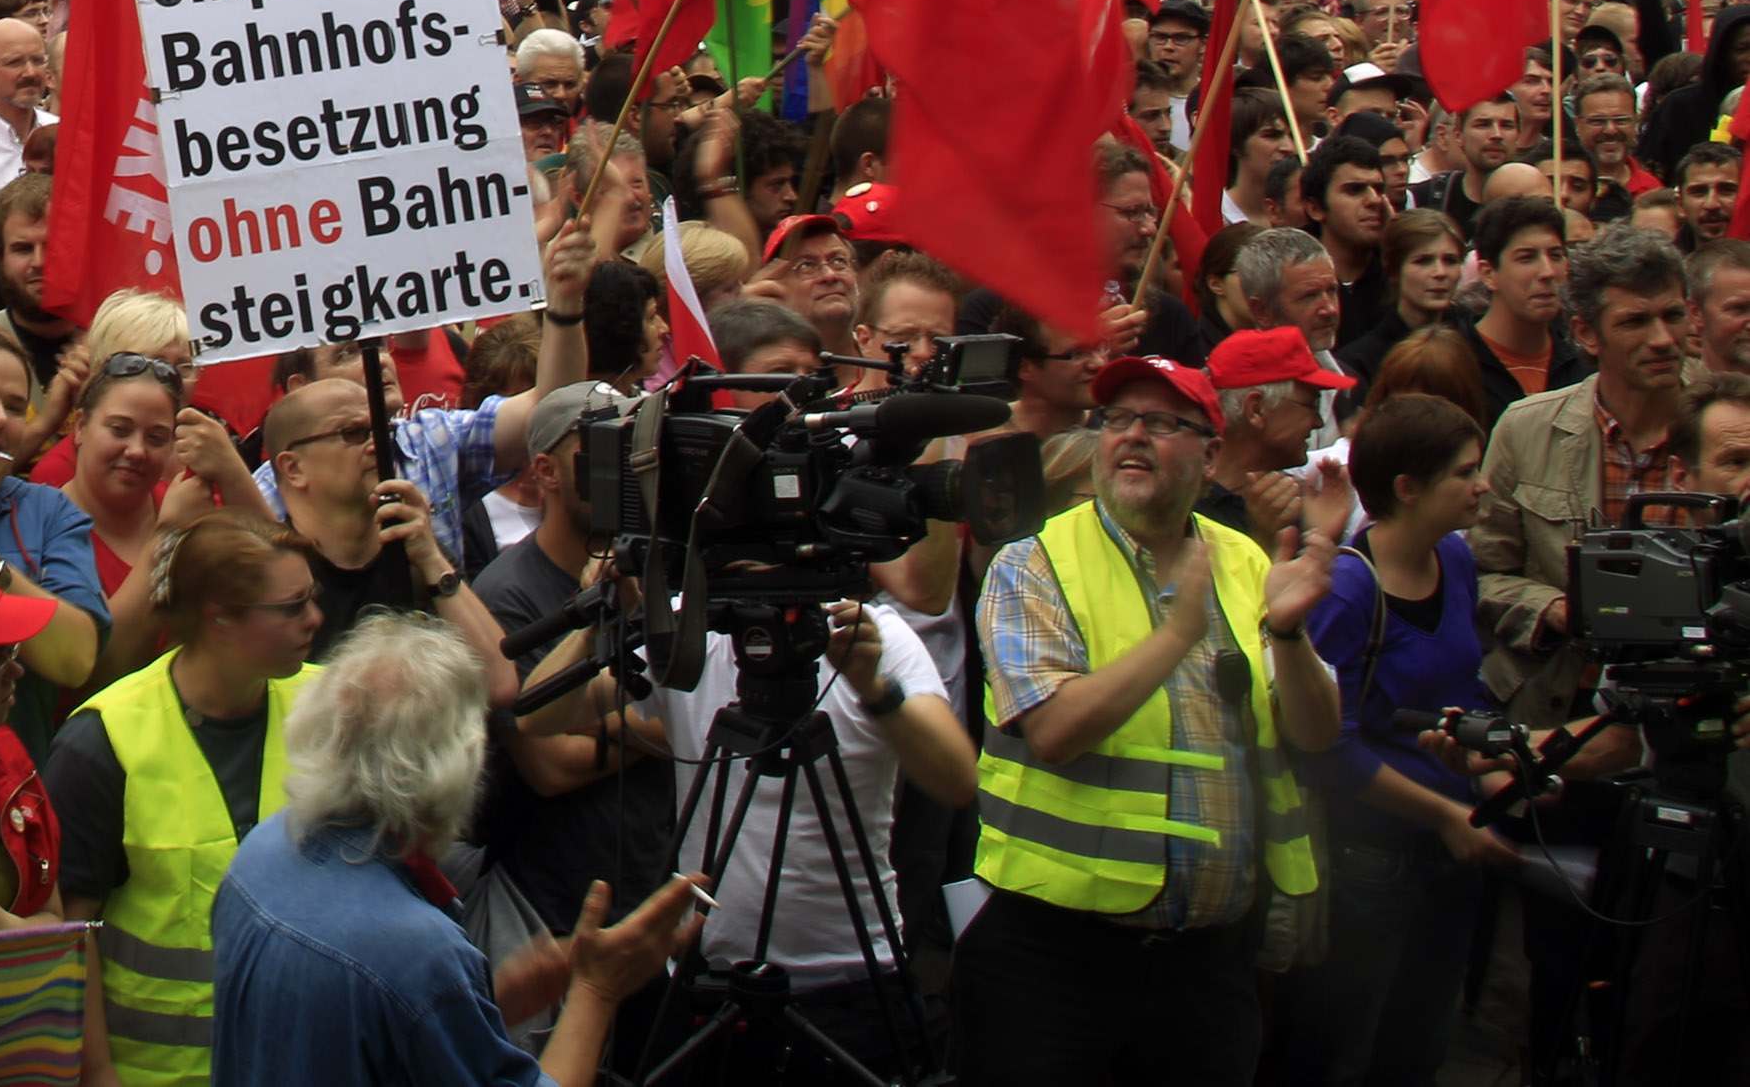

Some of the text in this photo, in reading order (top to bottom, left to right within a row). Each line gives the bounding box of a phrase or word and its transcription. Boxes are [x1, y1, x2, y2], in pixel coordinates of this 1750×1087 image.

[161, 0, 470, 92] Bahnhofs-
[173, 85, 489, 178] besetzung
[187, 166, 529, 263] ohne Bahn-
[199, 250, 531, 348] steigkarte.
